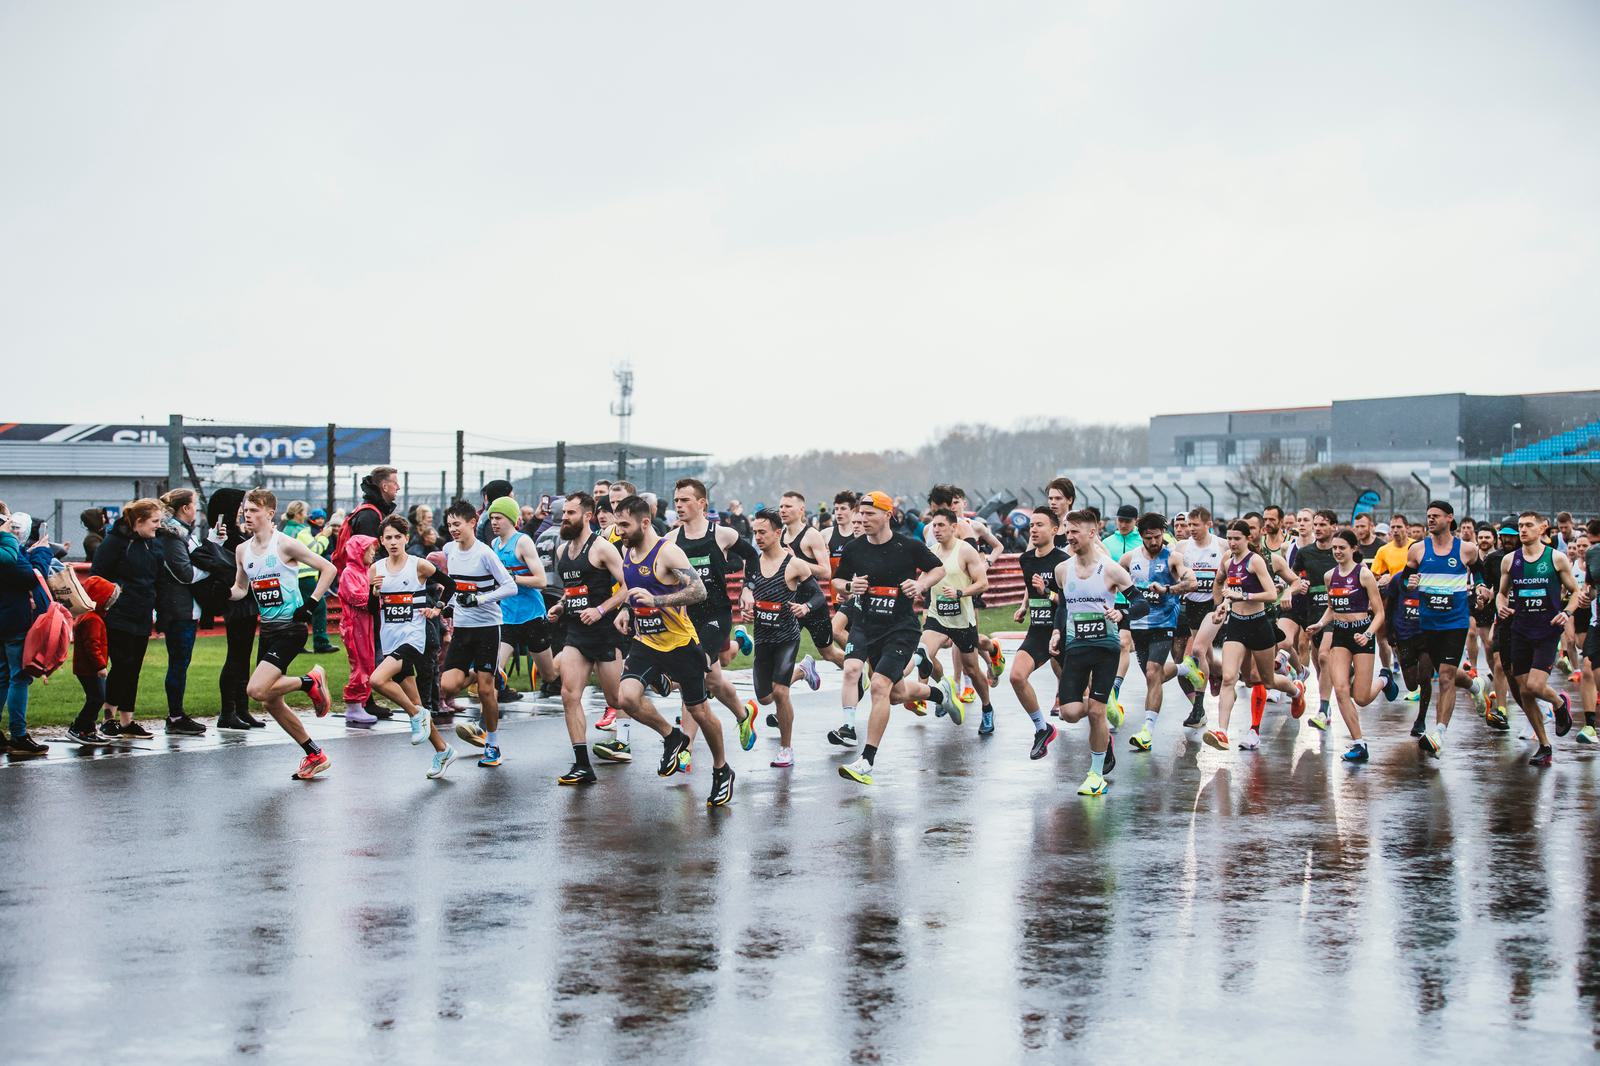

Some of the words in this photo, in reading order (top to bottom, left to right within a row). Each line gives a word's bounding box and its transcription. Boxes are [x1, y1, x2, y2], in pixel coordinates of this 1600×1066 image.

[112, 430, 316, 459] Silstone
[1513, 577, 1549, 585] DACORUM
[256, 590, 280, 600] 7679
[567, 597, 588, 608] 7298
[870, 597, 896, 608] 7716
[1430, 596, 1449, 605] 254
[1524, 599, 1543, 607] 179
[385, 606, 411, 615] 7634
[756, 610, 780, 621] 7867
[638, 617, 661, 627] 7550
[1077, 622, 1105, 633] 5573
